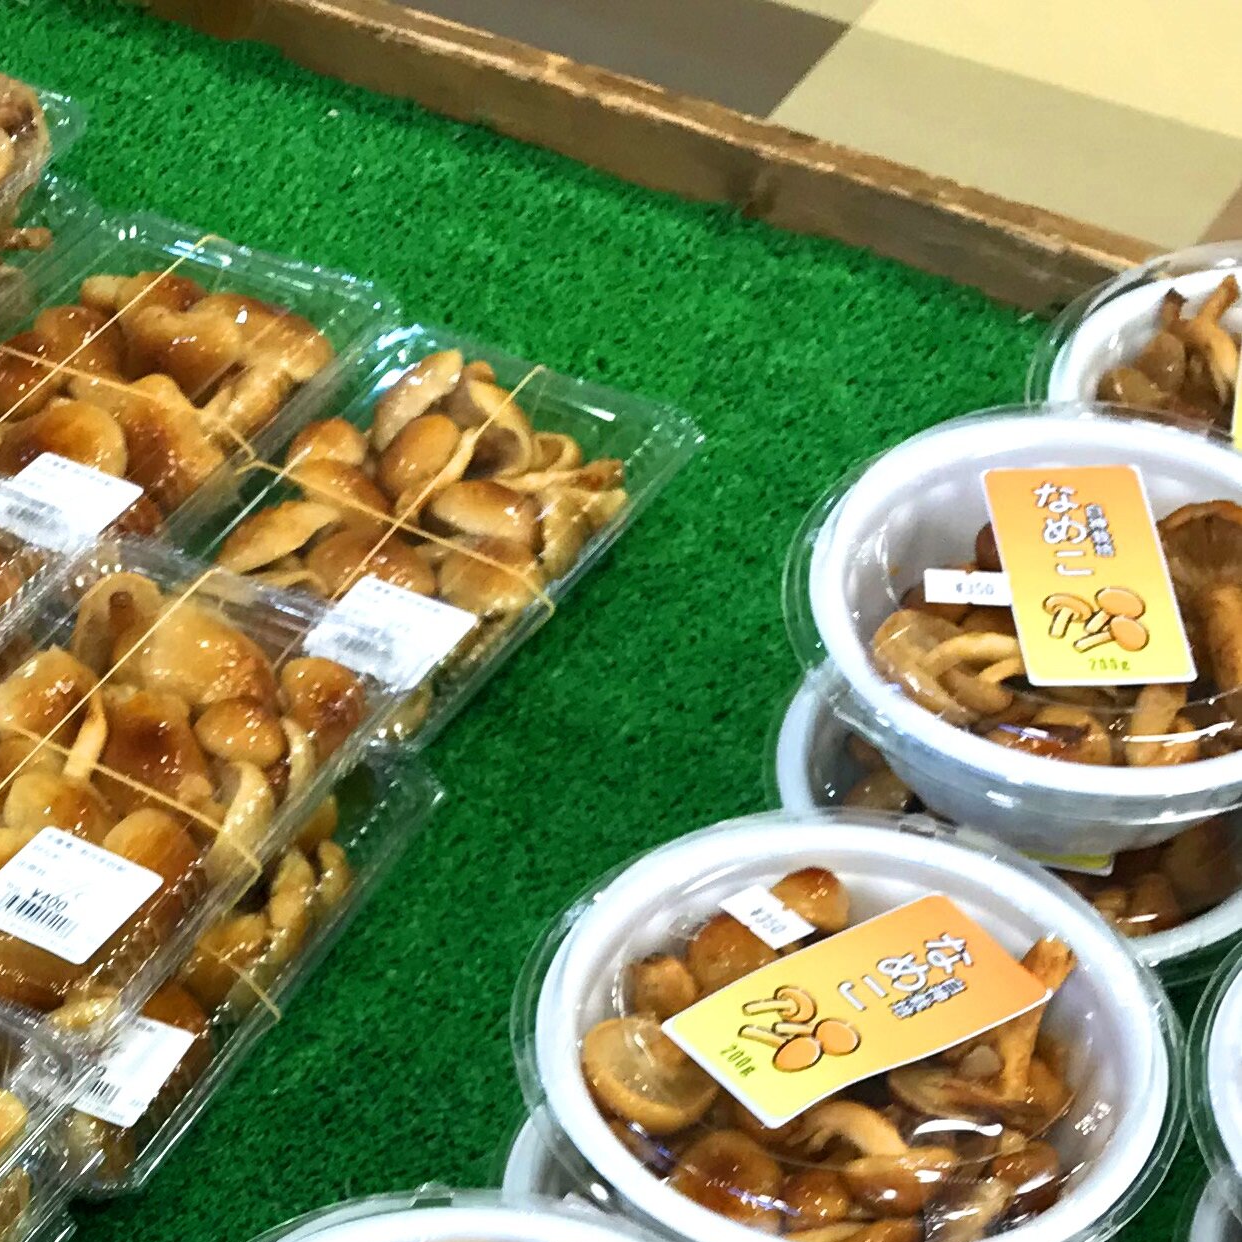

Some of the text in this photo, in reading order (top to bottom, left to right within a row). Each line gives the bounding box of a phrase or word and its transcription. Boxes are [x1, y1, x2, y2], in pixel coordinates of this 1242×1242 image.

[1033, 482, 1095, 577] なめこ
[30, 887, 69, 913] ¥400
[838, 931, 974, 1011] なめこ
